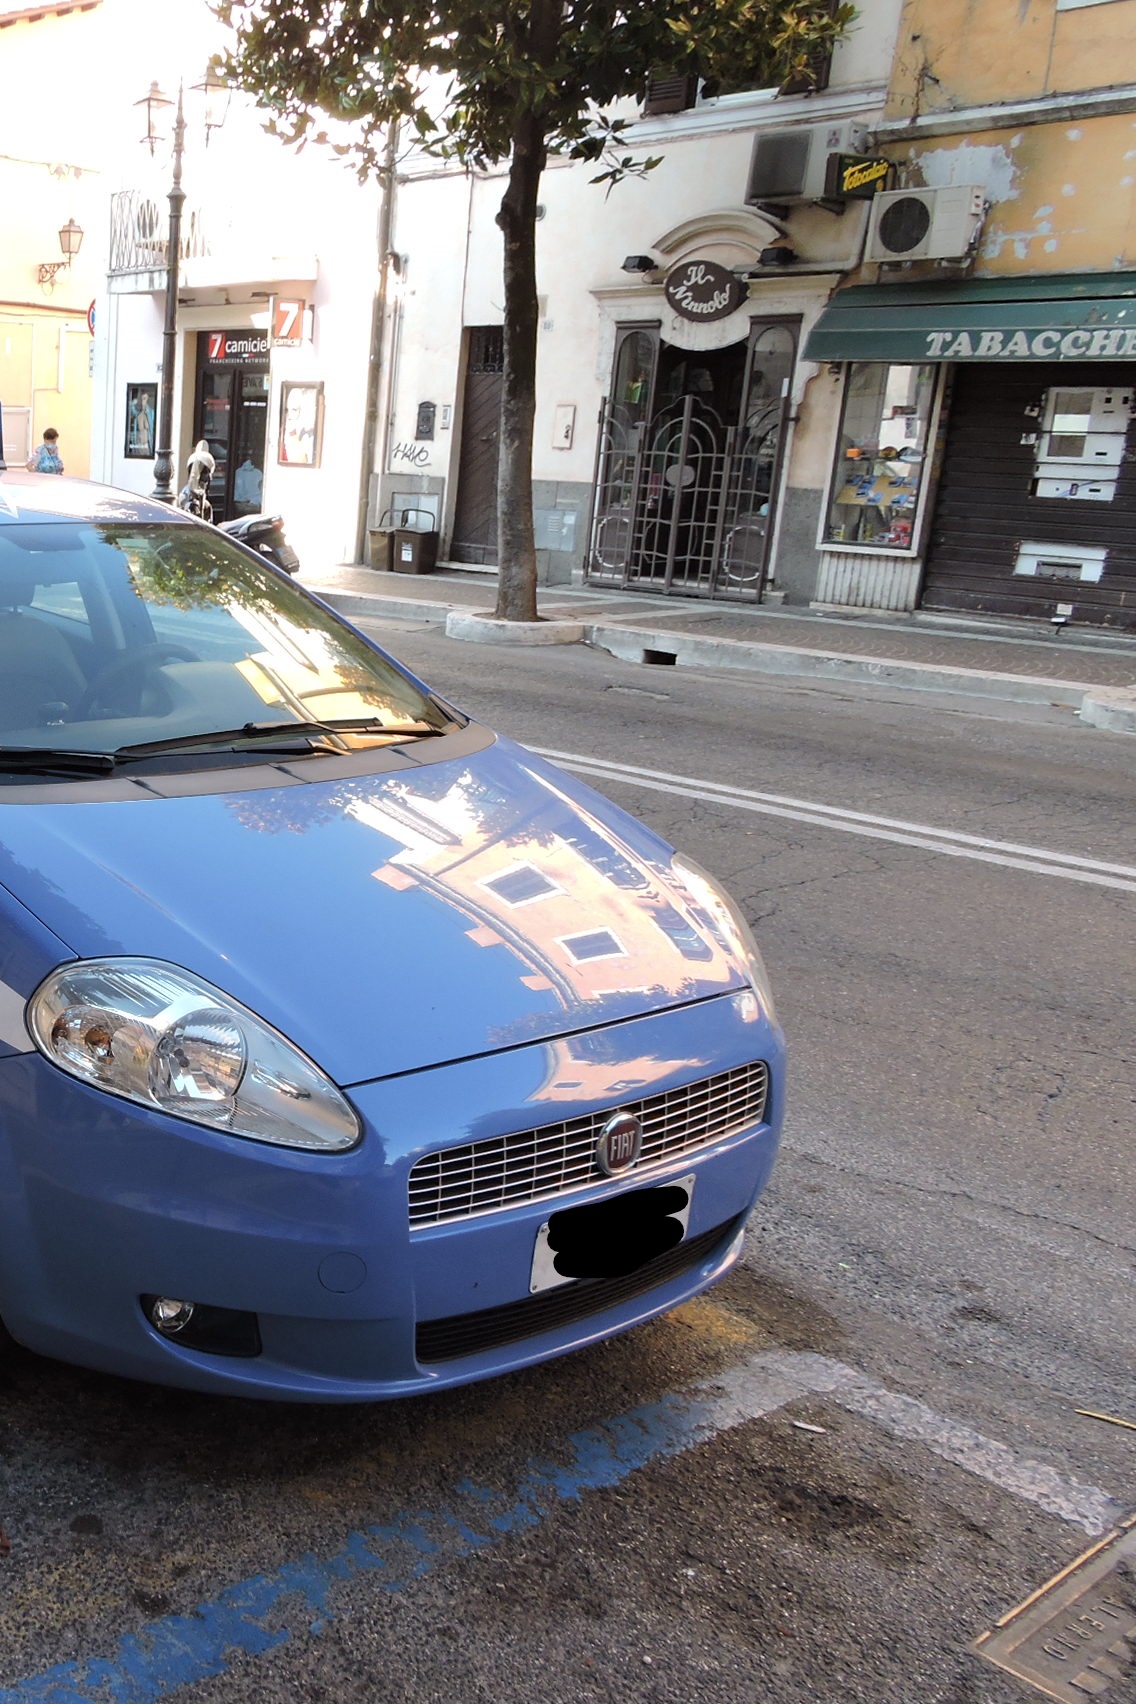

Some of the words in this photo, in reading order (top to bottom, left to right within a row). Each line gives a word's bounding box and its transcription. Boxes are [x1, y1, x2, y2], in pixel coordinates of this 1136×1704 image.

[683, 264, 715, 286] Il
[279, 302, 299, 337] 7
[210, 333, 223, 358] 7
[225, 337, 267, 353] camicie
[610, 1130, 636, 1161] FIAT
